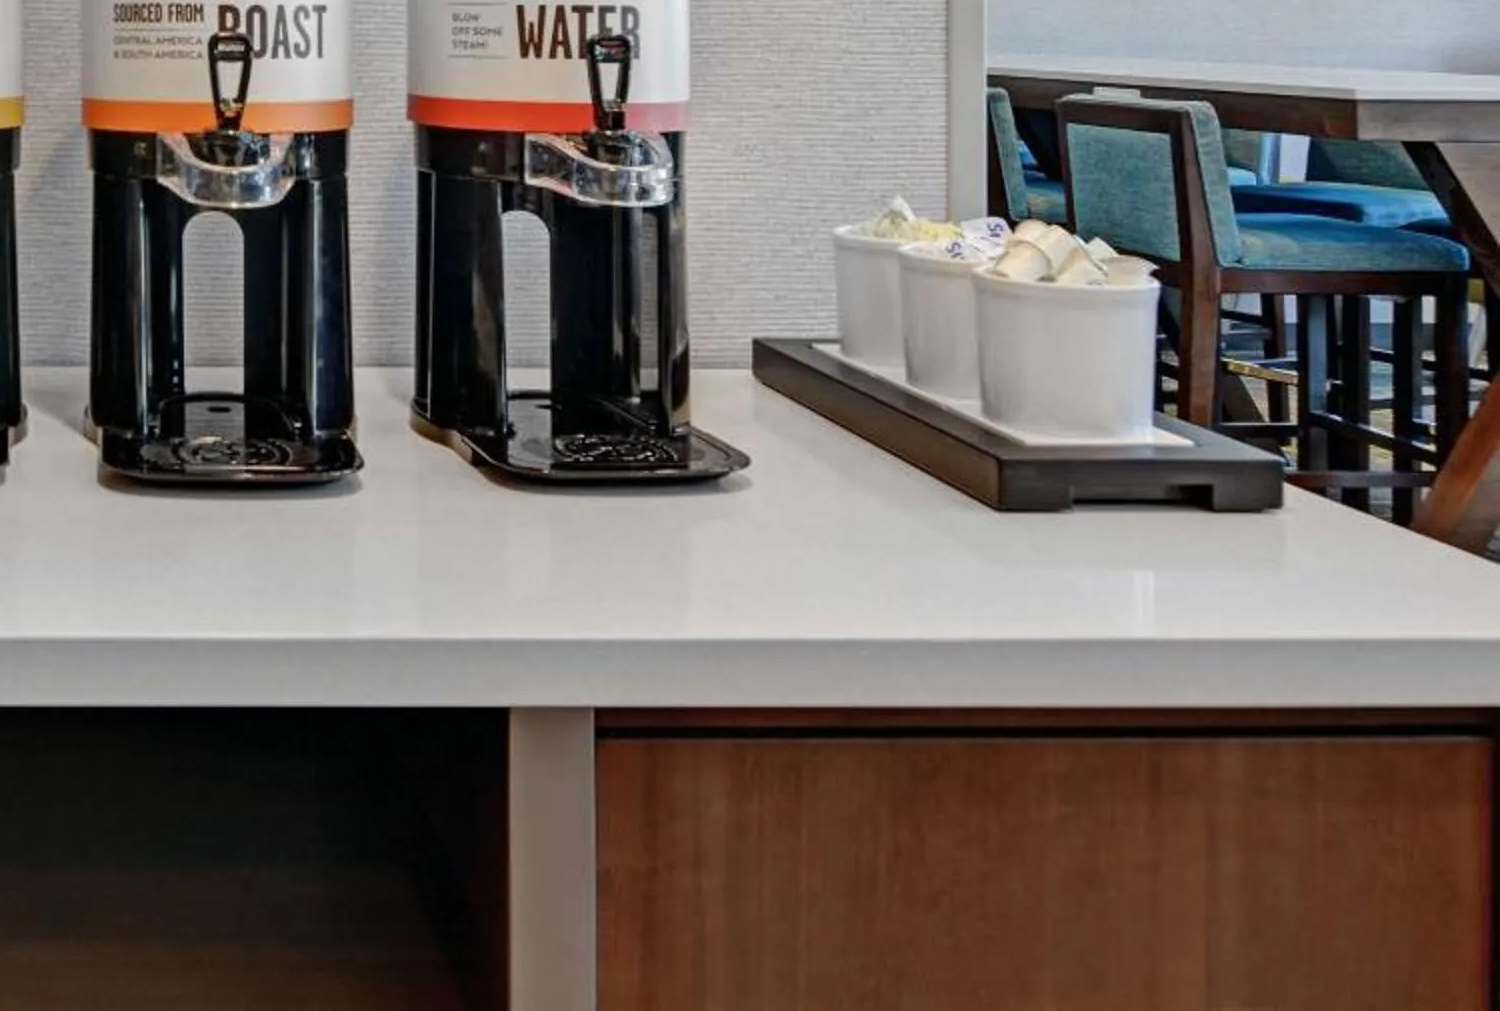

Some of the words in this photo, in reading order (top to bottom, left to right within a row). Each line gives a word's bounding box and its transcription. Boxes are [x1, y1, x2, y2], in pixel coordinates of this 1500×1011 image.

[113, 3, 162, 23] SOURCED
[168, 3, 204, 23] FROM
[516, 4, 641, 59] WATER
